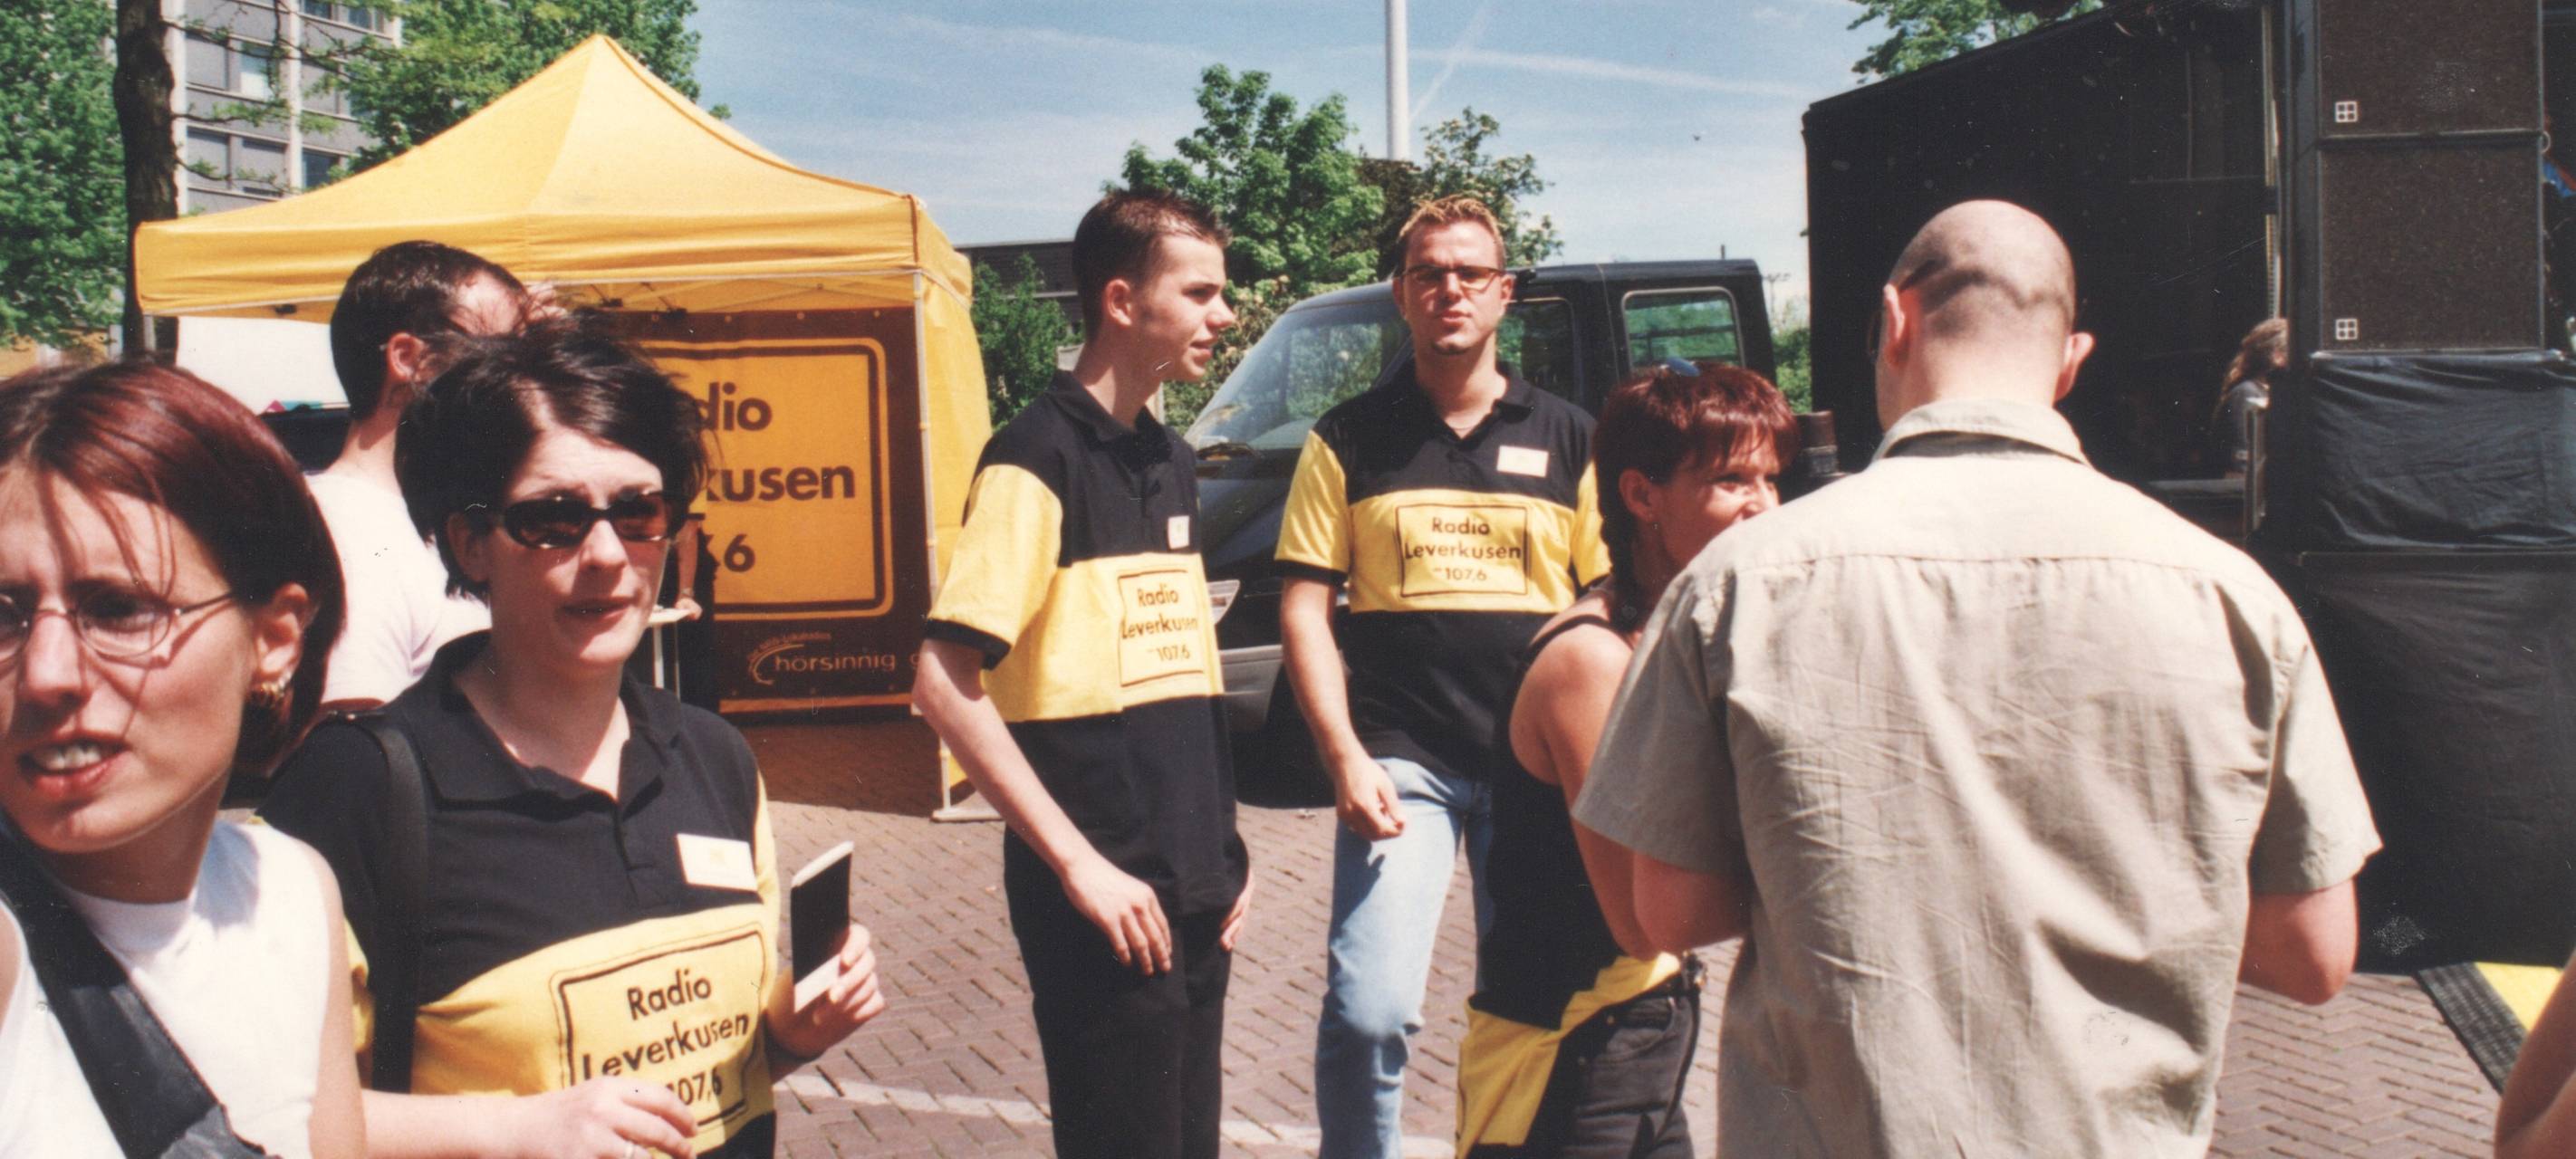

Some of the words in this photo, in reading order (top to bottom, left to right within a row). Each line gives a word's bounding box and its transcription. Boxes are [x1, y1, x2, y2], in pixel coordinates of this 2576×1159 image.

[697, 381, 773, 431] dio
[1431, 516, 1491, 536] Radio
[1404, 541, 1523, 560] Leverkusen
[1445, 567, 1487, 582] 107,6
[1137, 583, 1179, 607] Radio
[627, 968, 712, 1020] Radio
[582, 1012, 750, 1081] Leverkusen
[666, 1066, 724, 1106] 07,6
